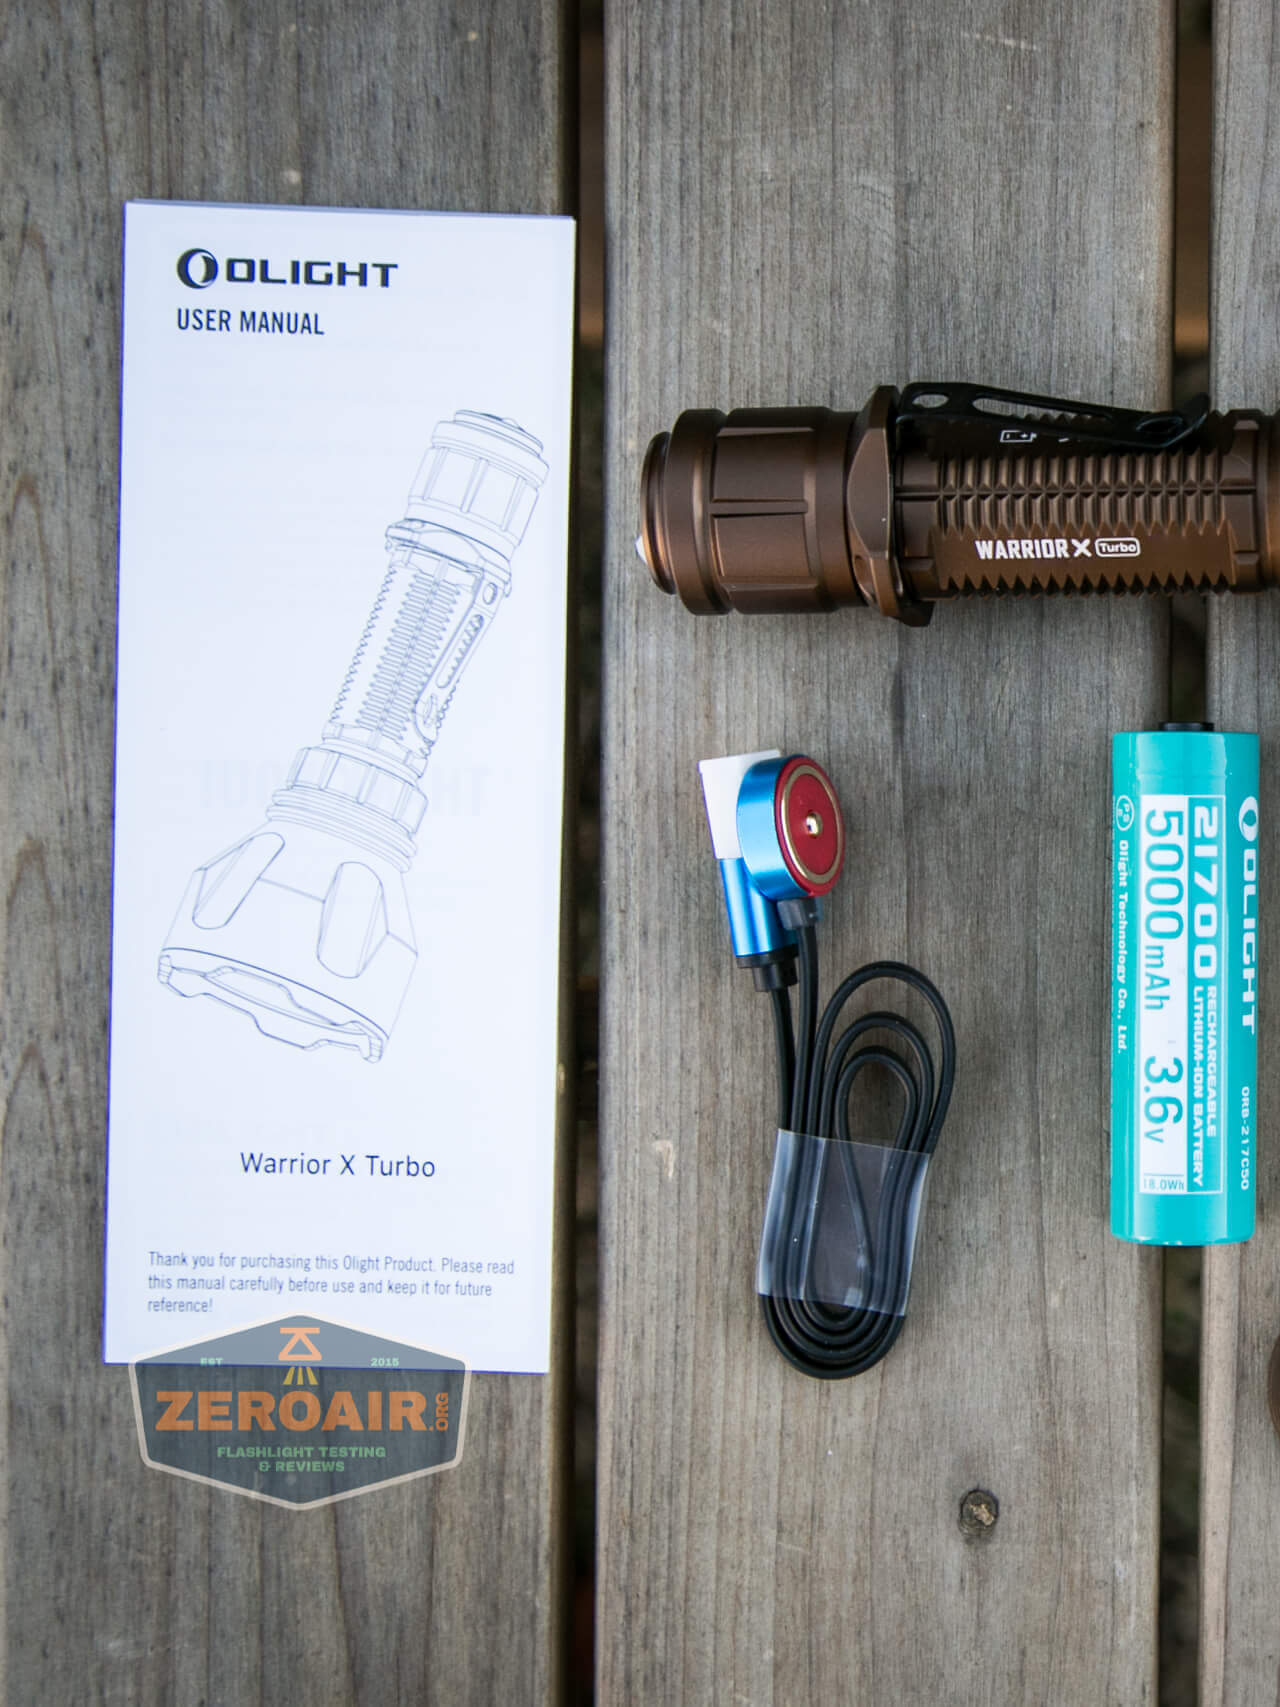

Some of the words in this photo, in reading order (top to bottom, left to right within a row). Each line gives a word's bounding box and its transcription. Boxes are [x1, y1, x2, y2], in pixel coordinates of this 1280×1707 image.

[226, 257, 398, 288] OLIGHT
[177, 308, 230, 332] USER
[240, 310, 325, 335] MANUAL
[975, 538, 1070, 560] WARRIOR
[1072, 538, 1091, 557] X
[1100, 541, 1137, 554] Turbo
[1117, 840, 1128, 886] Olight
[1194, 806, 1218, 978] 21700
[1117, 892, 1128, 983] Technology
[1243, 849, 1256, 1035] OLIGHT
[1118, 1026, 1127, 1054] Ltd.
[1194, 986, 1204, 1099] LITHIUM-ION
[1207, 986, 1217, 1137] RECHARGEABLE
[1193, 1104, 1203, 1187] BATTERY
[1241, 1087, 1250, 1190] ORB-217C50
[240, 1152, 330, 1175] Warrior
[340, 1154, 356, 1175] X
[365, 1155, 435, 1178] Turbo
[149, 1251, 187, 1267] Thank
[192, 1254, 214, 1270] you
[219, 1252, 236, 1268] for
[241, 1254, 311, 1271] purchasing
[315, 1254, 338, 1270] this
[343, 1255, 379, 1273] Olight
[441, 1257, 482, 1273] Please
[487, 1258, 514, 1274] read
[148, 1275, 172, 1290] this
[177, 1276, 224, 1291] manual
[229, 1276, 284, 1294] carefully
[288, 1278, 328, 1293] before
[332, 1280, 355, 1293] use
[359, 1279, 383, 1294] and
[388, 1280, 417, 1297] keep
[422, 1281, 430, 1295] it
[434, 1280, 451, 1295] for
[455, 1281, 492, 1296] future
[148, 1298, 213, 1313] reference!
